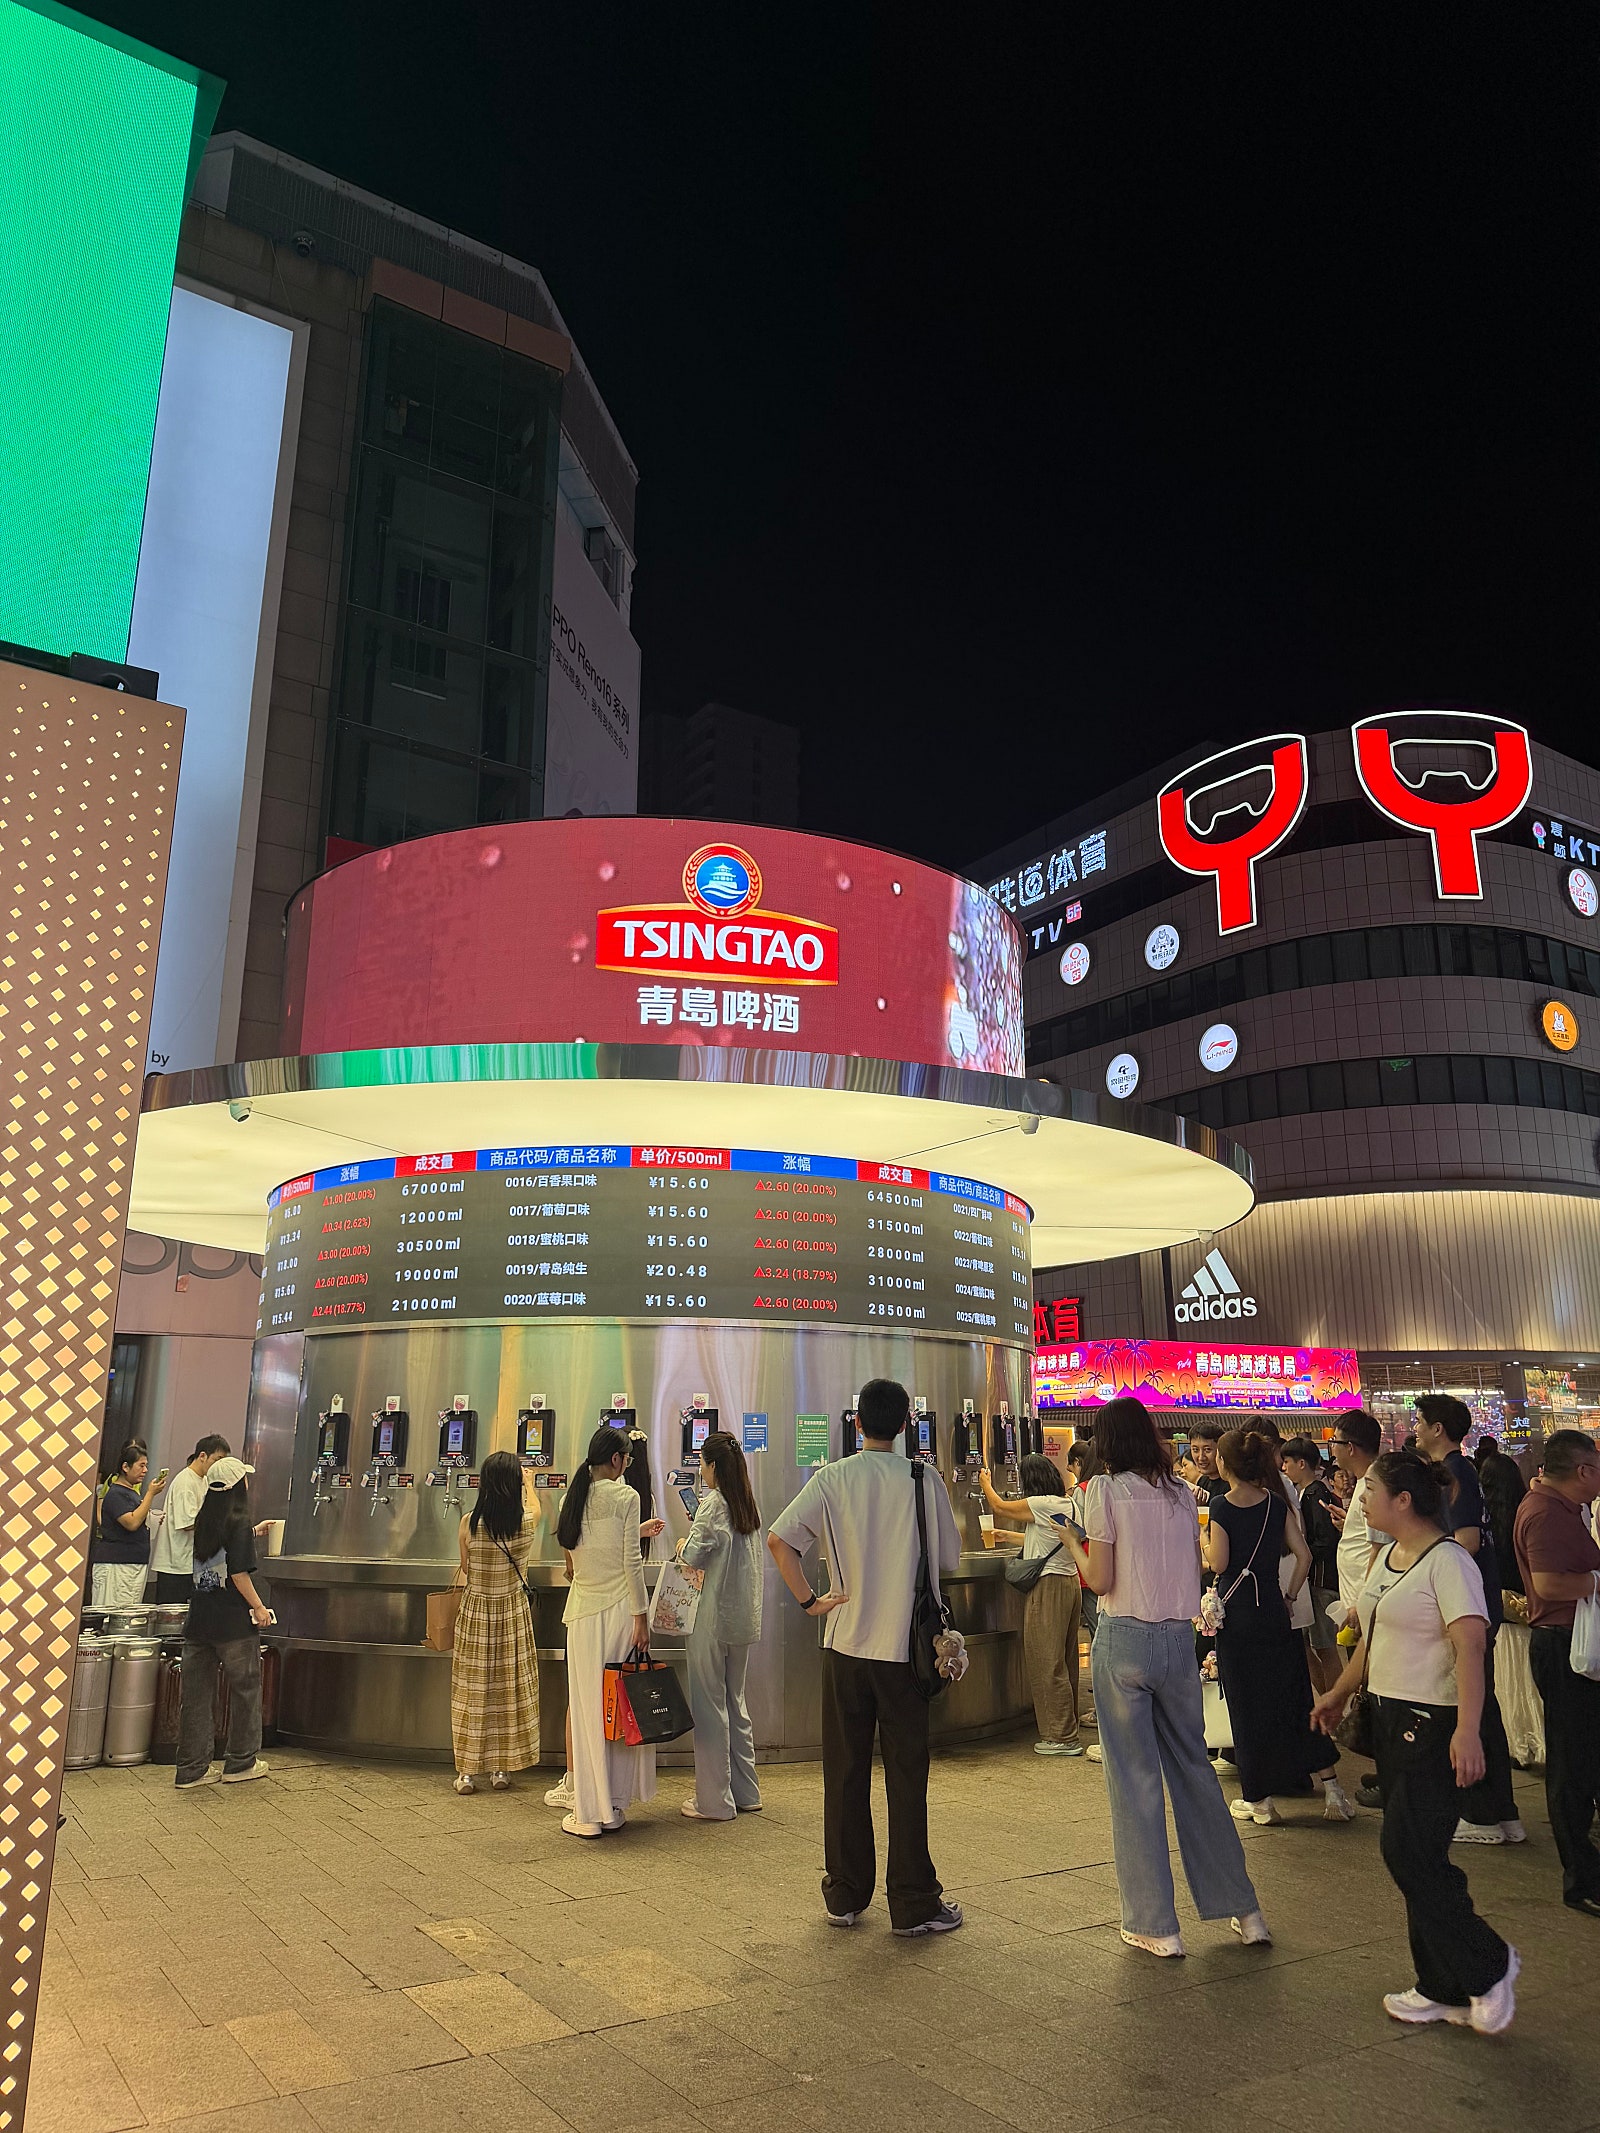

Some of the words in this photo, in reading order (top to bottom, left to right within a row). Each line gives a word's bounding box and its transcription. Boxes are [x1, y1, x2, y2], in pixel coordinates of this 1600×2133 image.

[578, 641, 612, 707] Reno16
[612, 693, 630, 735] 系列
[1066, 902, 1081, 919] 5F
[612, 920, 824, 972] TSINGTAO
[636, 985, 800, 1033] 青島啤酒
[151, 1049, 170, 1067] by
[1119, 1083, 1129, 1094] 5F
[414, 1154, 454, 1172] 成交量
[490, 1148, 617, 1166] 商品代码/商品名称
[640, 1148, 722, 1165] 单价/500ml
[782, 1155, 811, 1172] 涨幅
[878, 1166, 913, 1184] 成交量
[505, 1174, 598, 1188] 0016/百香果口味
[792, 1182, 837, 1198] (20.00%)
[510, 1202, 590, 1217] 0017/葡萄口味
[792, 1210, 837, 1226] (20.00%)
[508, 1232, 589, 1246] 0018/蜜桃口味
[792, 1240, 837, 1255] (20.00%)
[274, 1284, 296, 1298] ¥15.60
[505, 1262, 588, 1276] 0019/青岛纯生
[792, 1268, 838, 1284] (18.79%)
[272, 1310, 293, 1326] ¥15.44
[504, 1292, 586, 1306] 0020/蓝莓口味
[792, 1297, 838, 1312] (20.00%)
[1174, 1295, 1258, 1323] adidas
[676, 1598, 692, 1608] you
